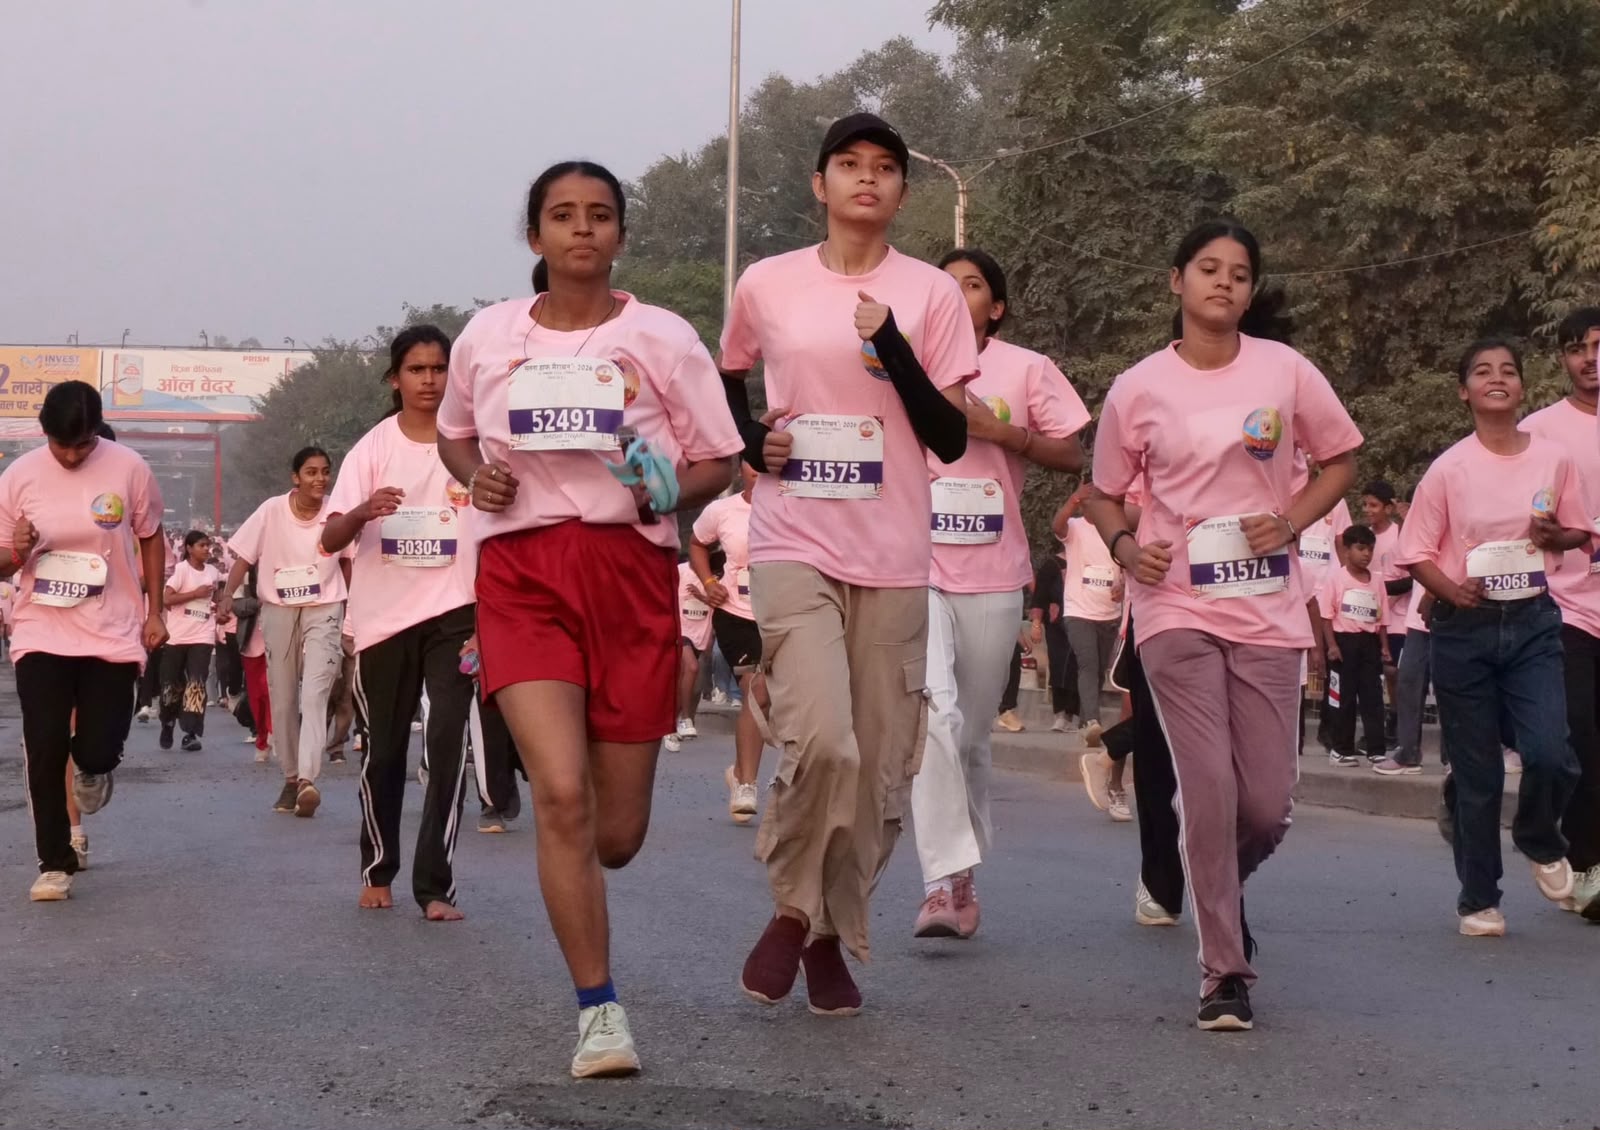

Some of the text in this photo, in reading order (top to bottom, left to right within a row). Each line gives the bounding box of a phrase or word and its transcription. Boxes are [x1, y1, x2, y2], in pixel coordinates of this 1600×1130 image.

[44, 354, 79, 363] INVEST
[242, 355, 270, 363] PRISM
[156, 375, 236, 393] ऑल वेदर
[531, 408, 598, 433] 52491
[800, 460, 861, 483] 51575
[936, 514, 986, 532] 51576
[396, 540, 442, 555] 50304
[1212, 557, 1271, 584] 51574
[47, 581, 89, 598] 53199
[1484, 573, 1530, 591] 52068
[284, 586, 311, 598] 51872
